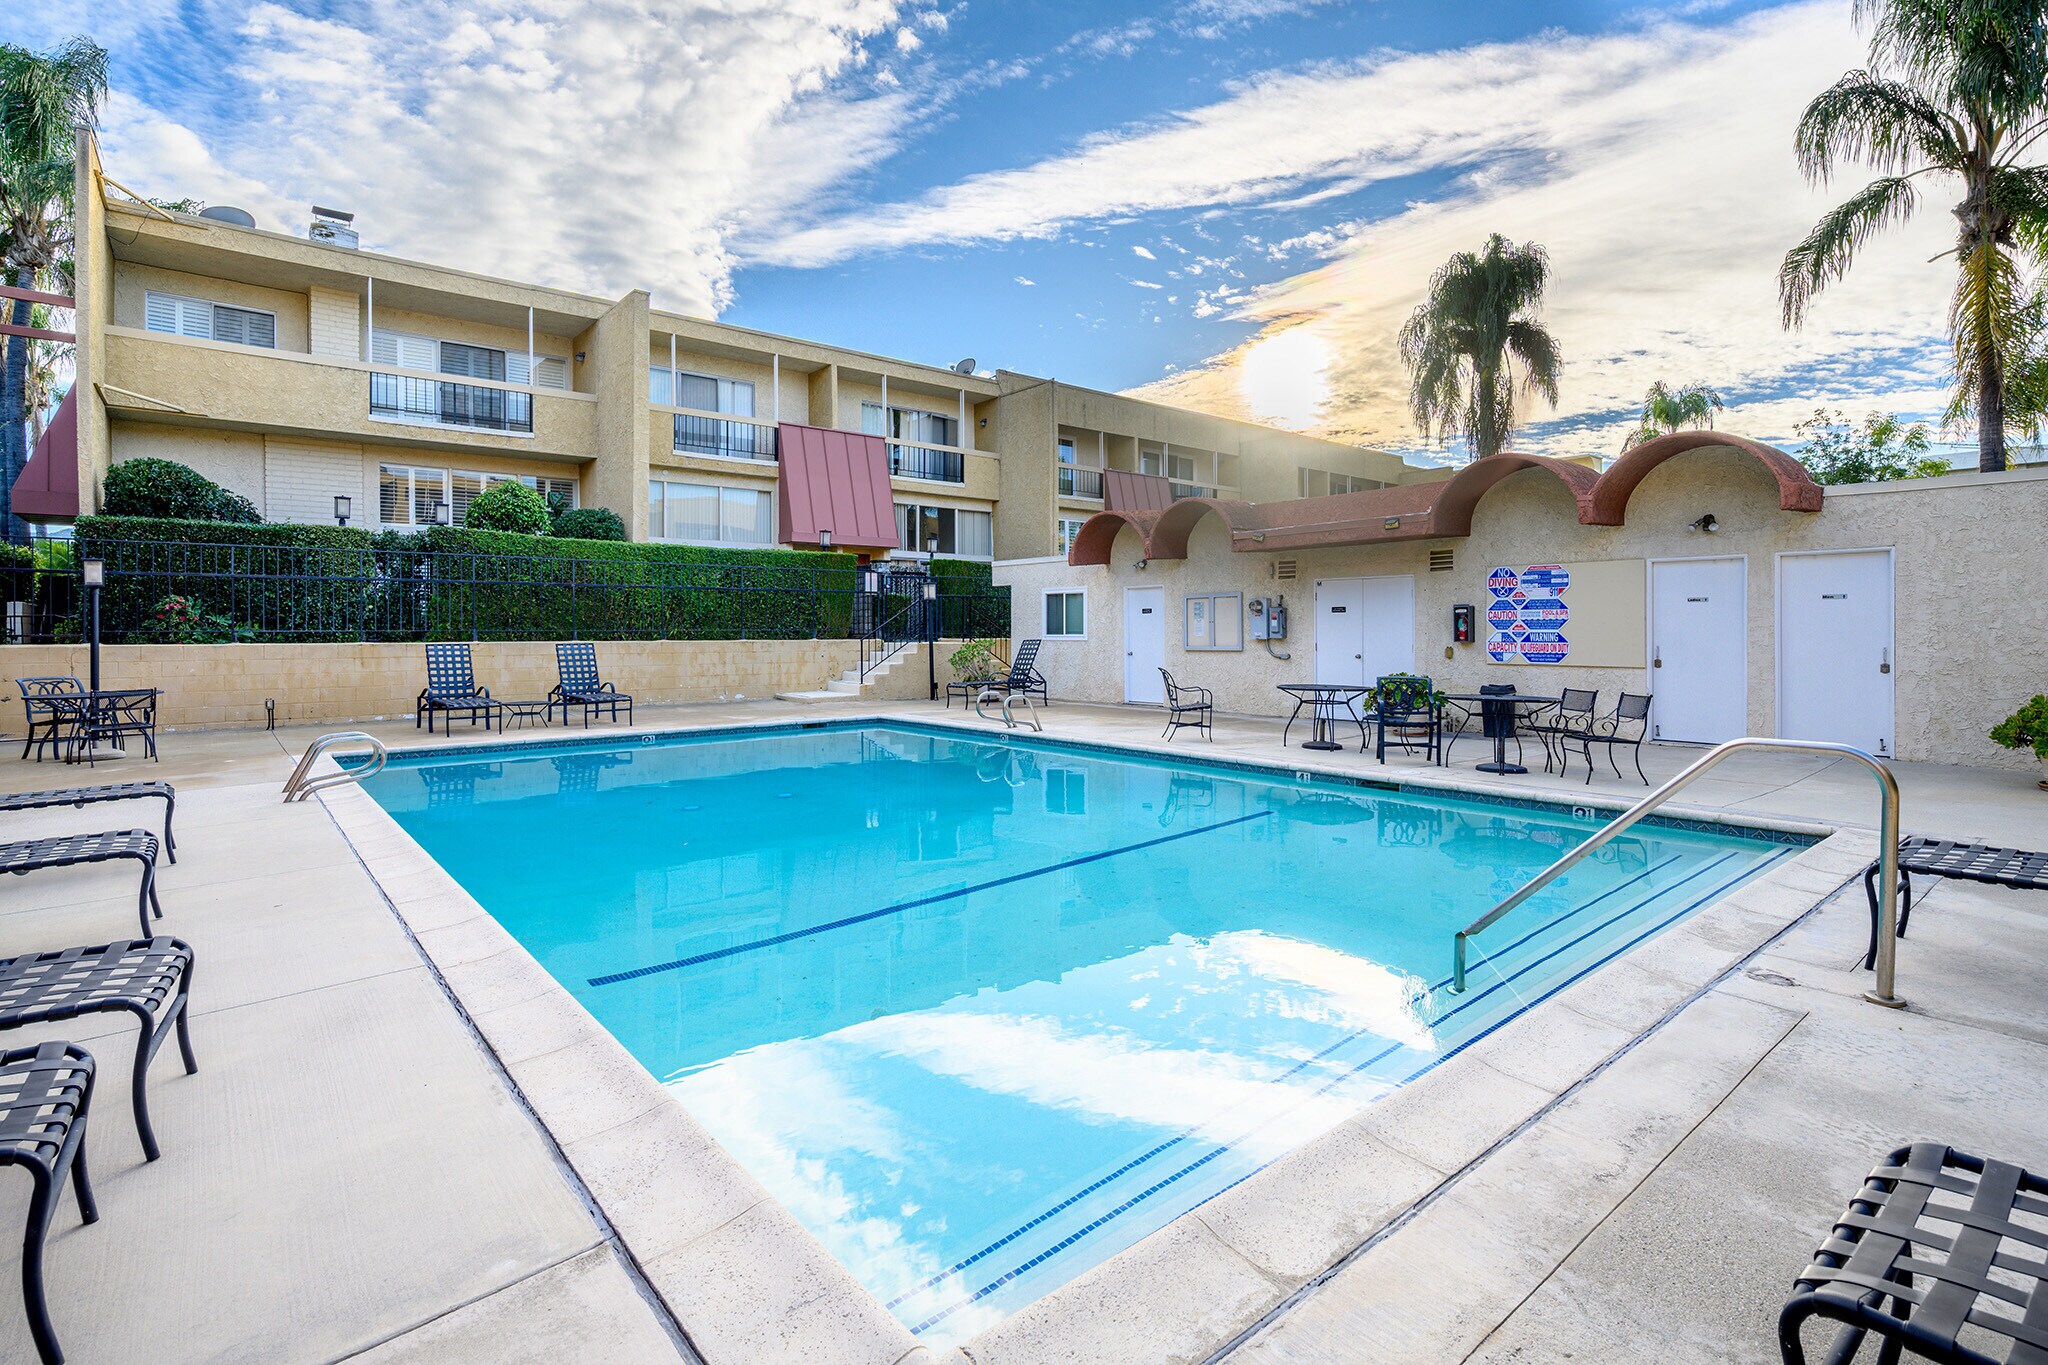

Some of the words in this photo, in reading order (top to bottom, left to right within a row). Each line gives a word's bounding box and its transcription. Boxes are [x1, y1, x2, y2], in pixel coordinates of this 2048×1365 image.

[1498, 568, 1510, 577] NO
[1488, 578, 1518, 587] DIVING
[1549, 588, 1558, 597] 911
[1488, 610, 1518, 619] CAUTION
[1530, 633, 1559, 642] WARNING
[1488, 642, 1518, 652] CAPACITY
[1520, 643, 1526, 652] NO
[1527, 643, 1549, 652] LIFEGUARD
[1549, 643, 1557, 652] ON
[1557, 643, 1569, 653] DUTY
